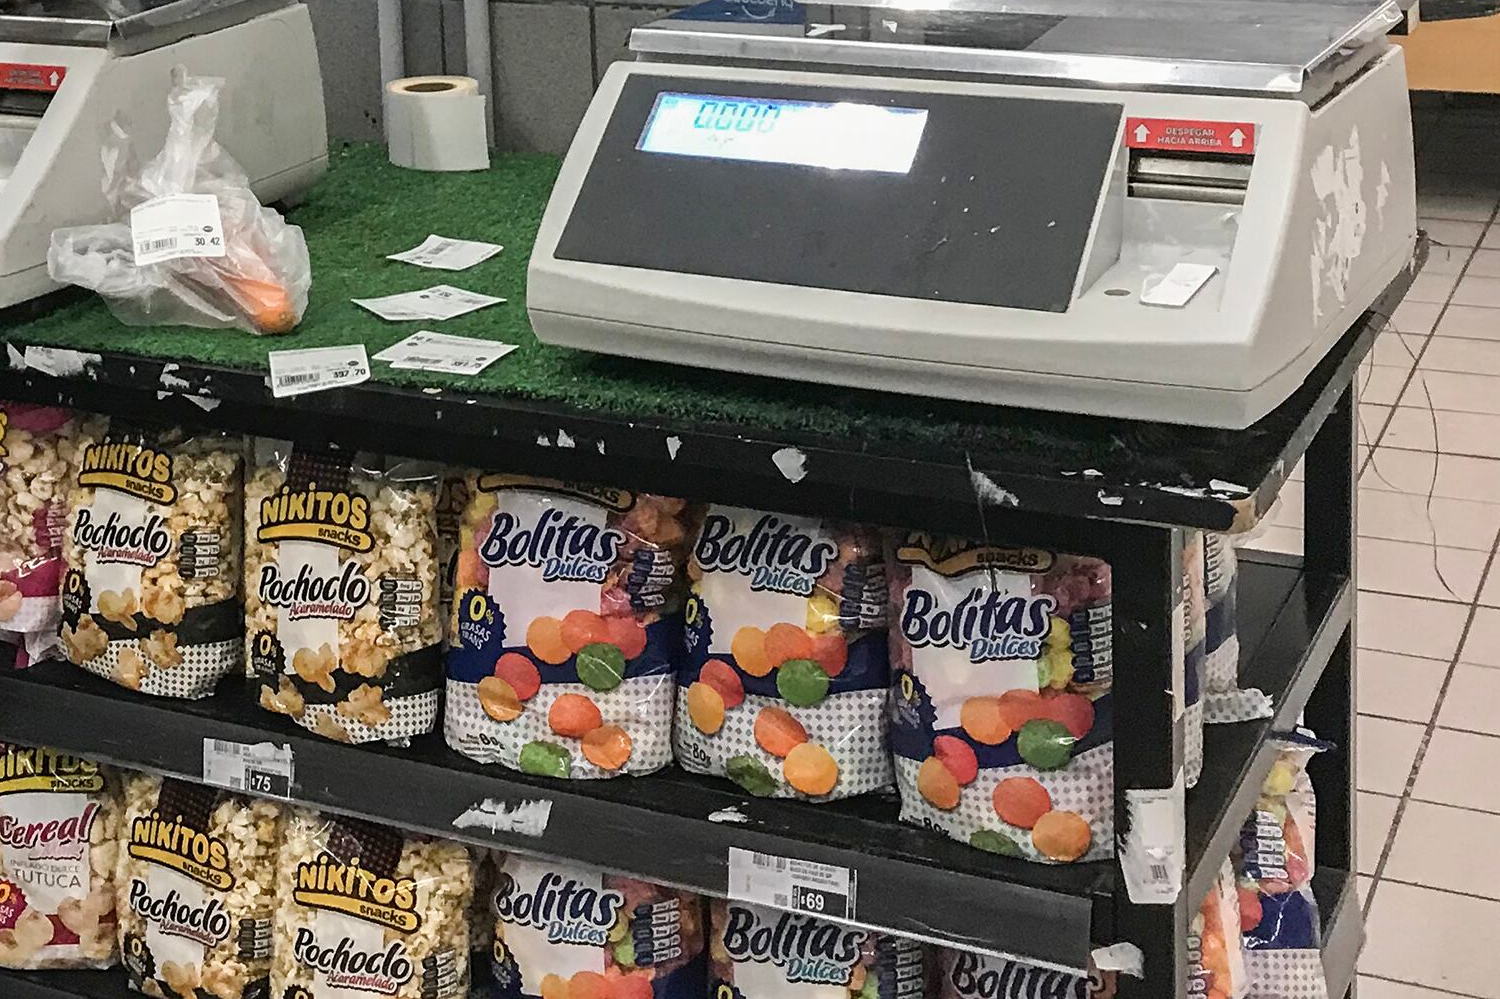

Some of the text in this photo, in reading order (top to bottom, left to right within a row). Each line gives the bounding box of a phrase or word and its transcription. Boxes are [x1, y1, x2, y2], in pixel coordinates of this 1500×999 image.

[1157, 137, 1222, 147] HACIA ARRIBA
[1165, 126, 1215, 137] DESPEGAR
[126, 480, 165, 500] snacks
[318, 527, 361, 546] snacks
[481, 507, 626, 563] Bolitas
[695, 514, 835, 574] Bolitas
[543, 557, 608, 580] Dulces
[752, 566, 812, 592] Dulces
[288, 601, 352, 617] Acaramelado
[902, 587, 1059, 645] Bolitas
[971, 638, 1040, 660] Dulces
[51, 779, 94, 789] snacks
[0, 803, 99, 846] Cereal
[13, 867, 82, 889] TUTUCA
[182, 861, 222, 886] snacks
[495, 872, 621, 926] Bolitas
[360, 904, 408, 927] snacks
[548, 920, 607, 943] Dulces
[723, 906, 865, 961] Bolitas
[787, 959, 850, 982] Dulces
